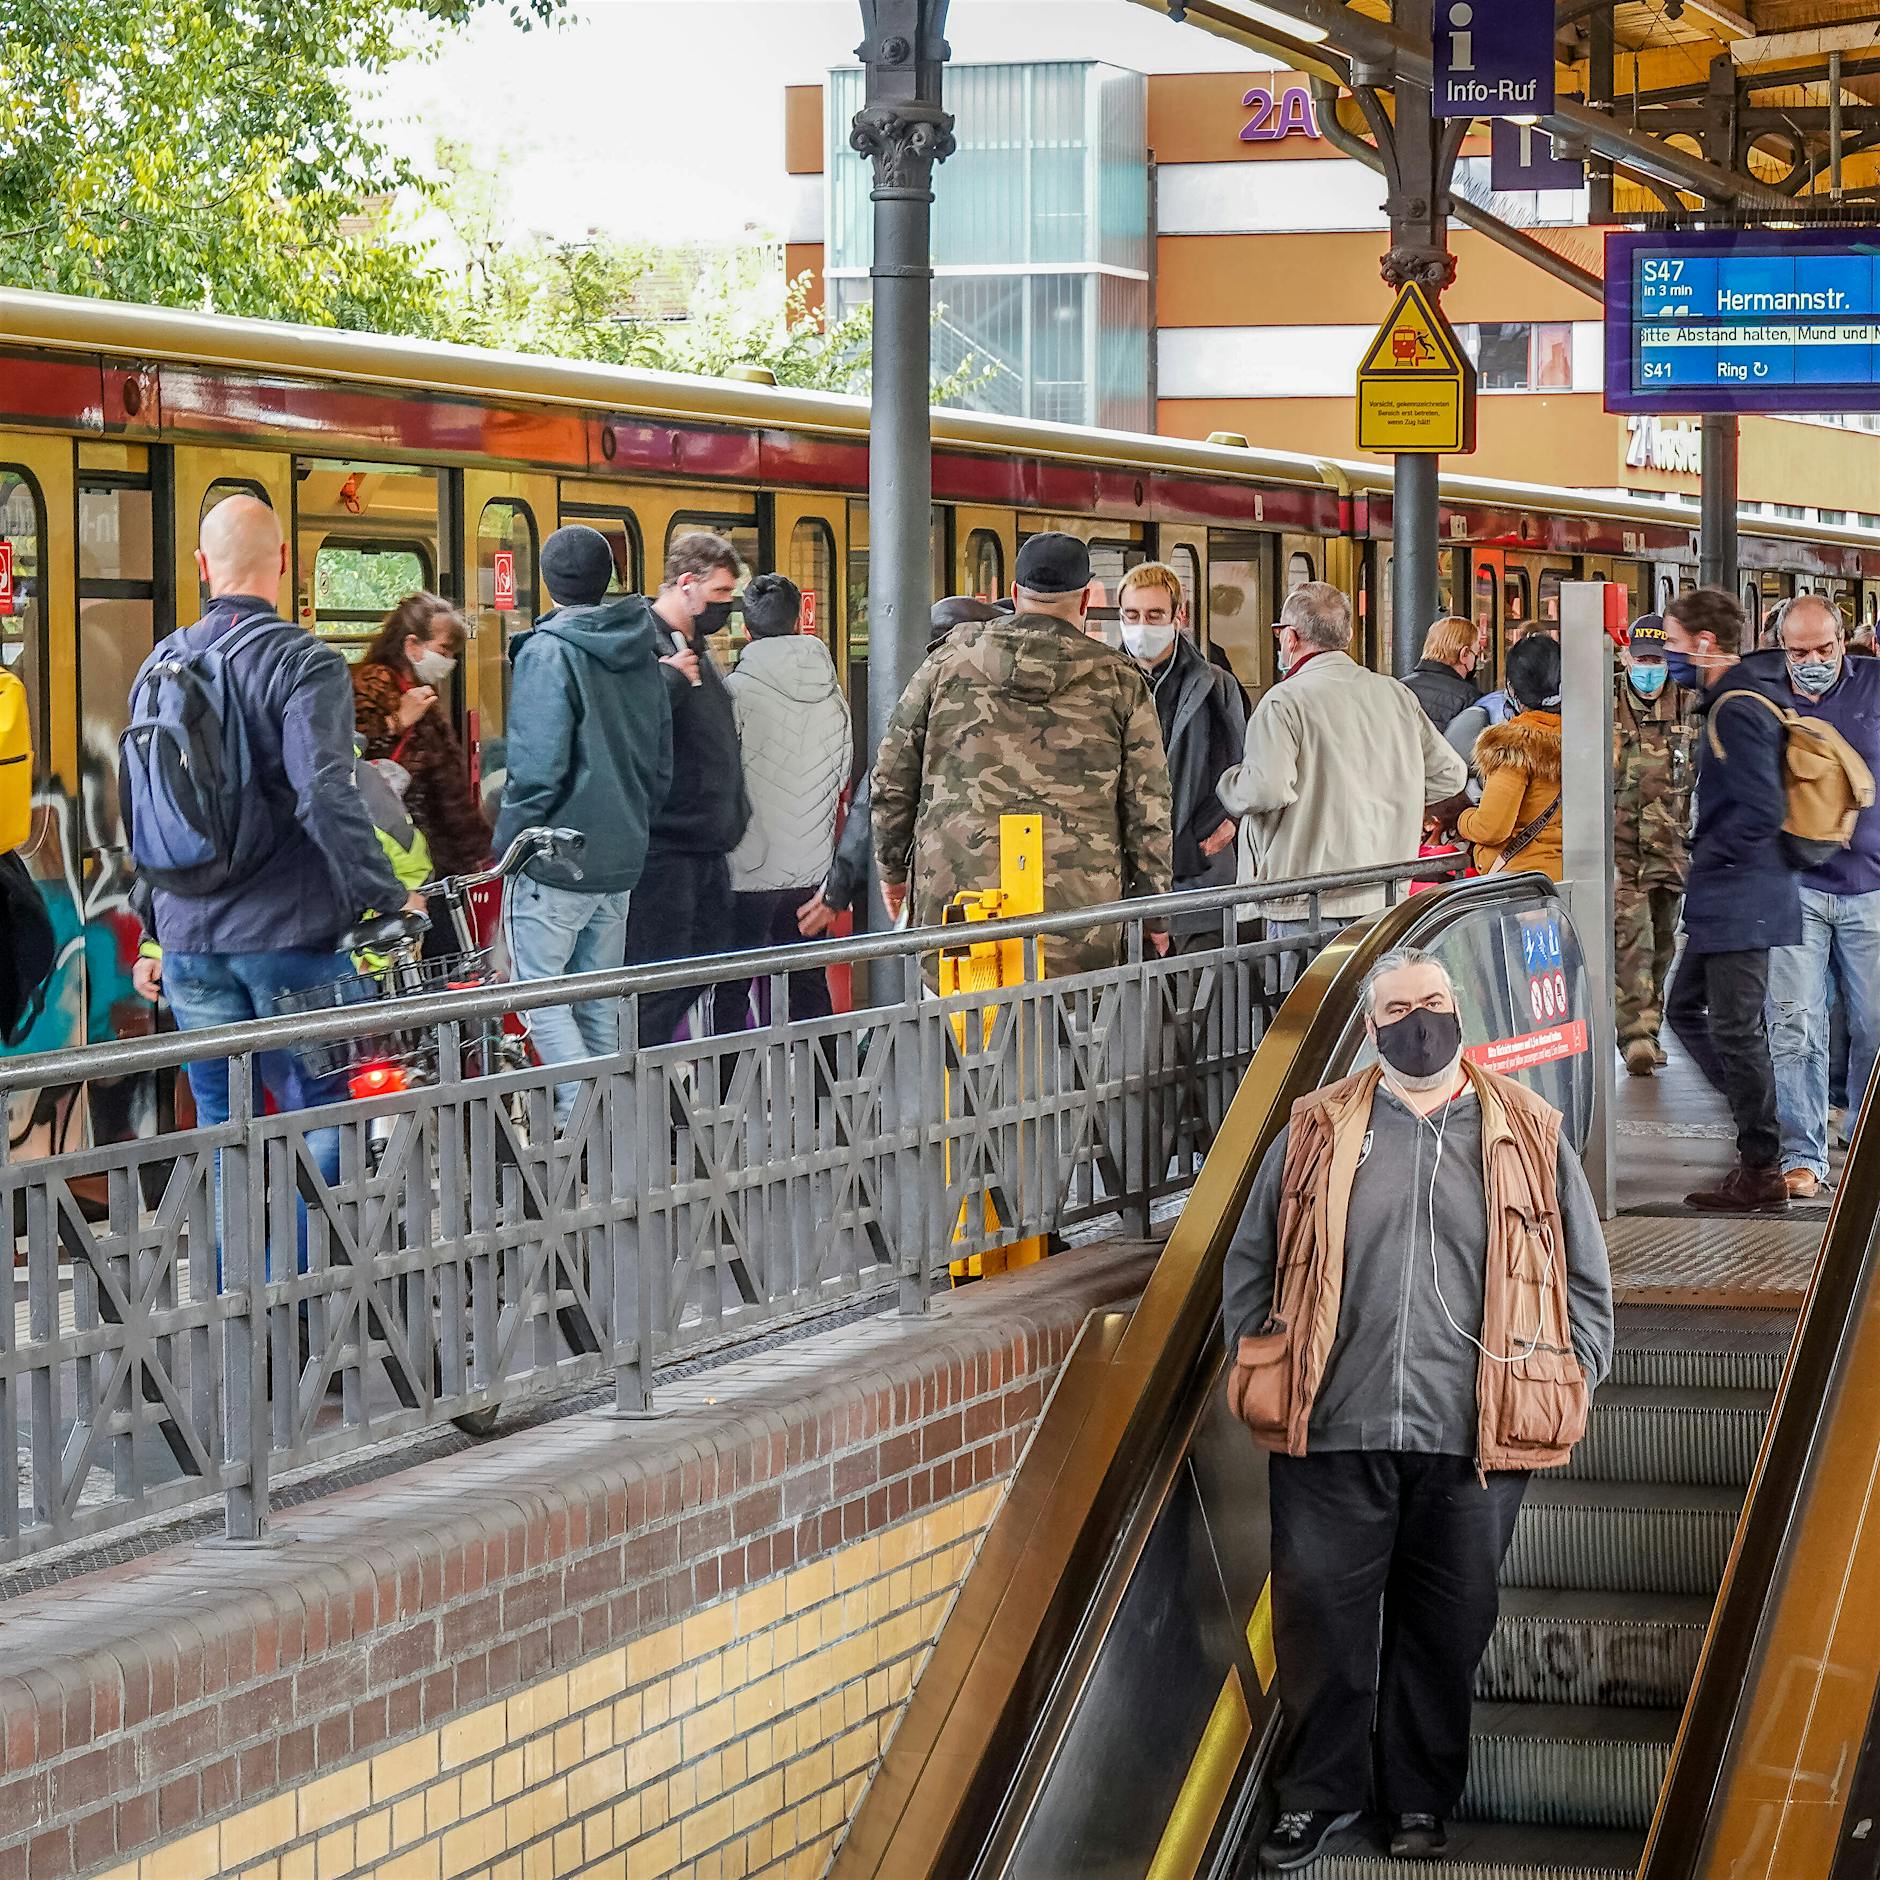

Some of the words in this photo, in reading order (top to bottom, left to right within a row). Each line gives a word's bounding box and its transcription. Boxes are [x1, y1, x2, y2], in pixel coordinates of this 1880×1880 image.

[1447, 79, 1537, 102] Info-Ruf
[1643, 260, 1685, 282] S47
[1643, 284, 1656, 297] in
[1659, 285, 1667, 296] 3
[1670, 284, 1693, 297] min
[1717, 287, 1850, 311] Hermannstr.
[1677, 326, 1737, 342] Abstand
[1743, 326, 1792, 343] halten,
[1798, 326, 1836, 340] Mund
[1843, 326, 1868, 339] und
[1643, 362, 1673, 378] S41
[1717, 361, 1748, 381] Ring
[1634, 628, 1669, 641] NYPD
